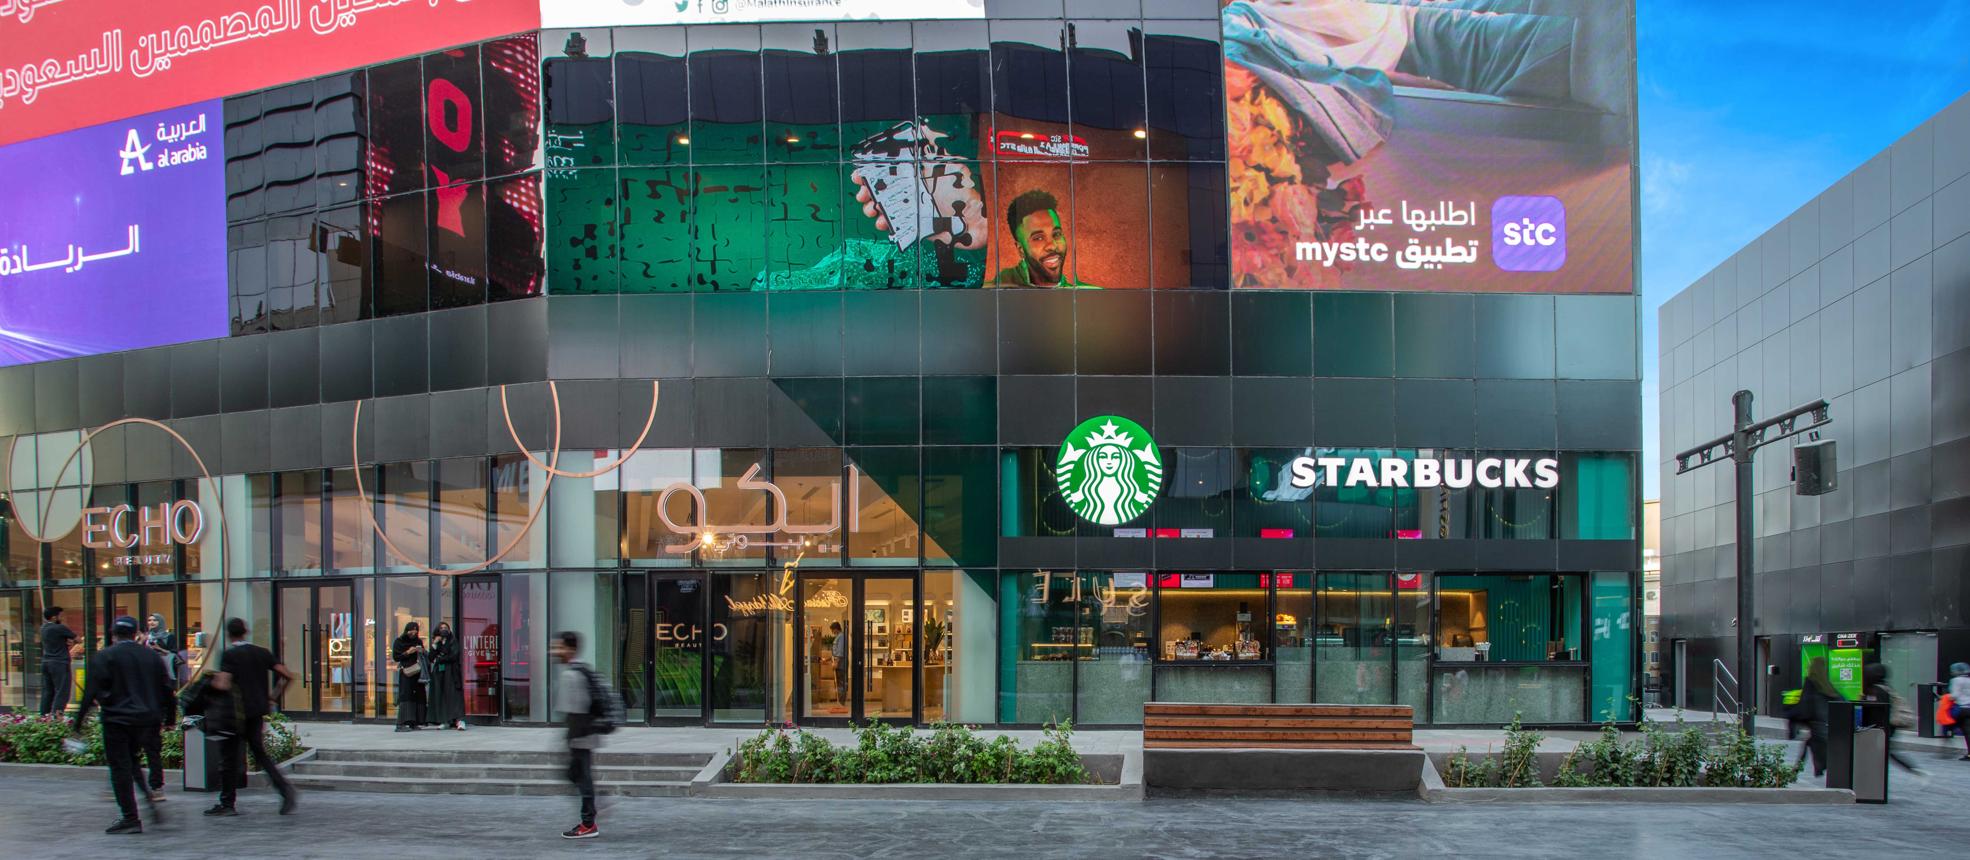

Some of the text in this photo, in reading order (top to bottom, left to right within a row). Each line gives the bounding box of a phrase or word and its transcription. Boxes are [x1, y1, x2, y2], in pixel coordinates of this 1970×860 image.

[156, 113, 206, 142] العربية
[1355, 200, 1476, 231] اطلبها عبر
[1503, 217, 1557, 246] stc
[1295, 237, 1479, 270] تطبيق mystc
[1291, 456, 1559, 489] STARBUCKS
[81, 499, 203, 549] ECHO
